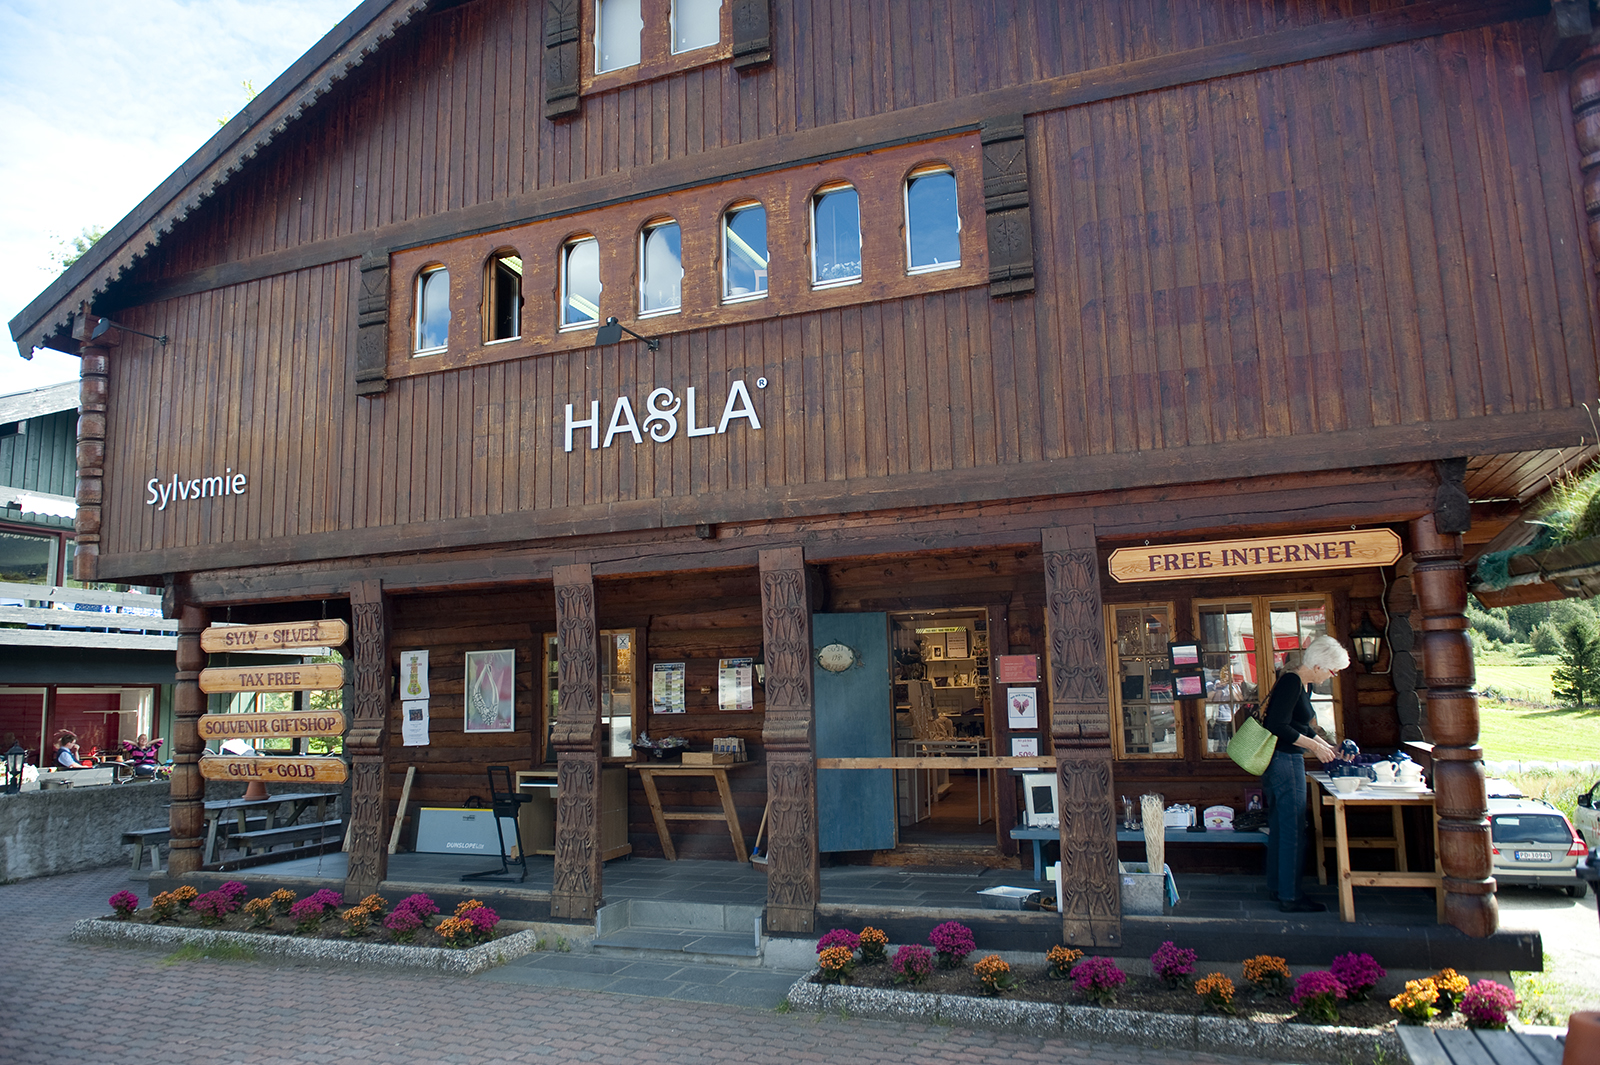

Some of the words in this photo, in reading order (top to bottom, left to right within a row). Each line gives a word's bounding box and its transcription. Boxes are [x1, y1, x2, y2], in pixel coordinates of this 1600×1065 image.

[146, 467, 248, 511] Sylvsmie
[1147, 550, 1212, 574] FREE
[1221, 540, 1356, 567] INTERNET
[225, 630, 258, 646] SYLV
[272, 627, 320, 643] SILVER
[239, 673, 263, 687] TAX
[267, 671, 301, 686] FREE
[205, 719, 268, 735] SOUVENIR
[271, 716, 337, 732] GIFTSHOP
[228, 763, 263, 777] GULL
[276, 764, 315, 778] GOLD
